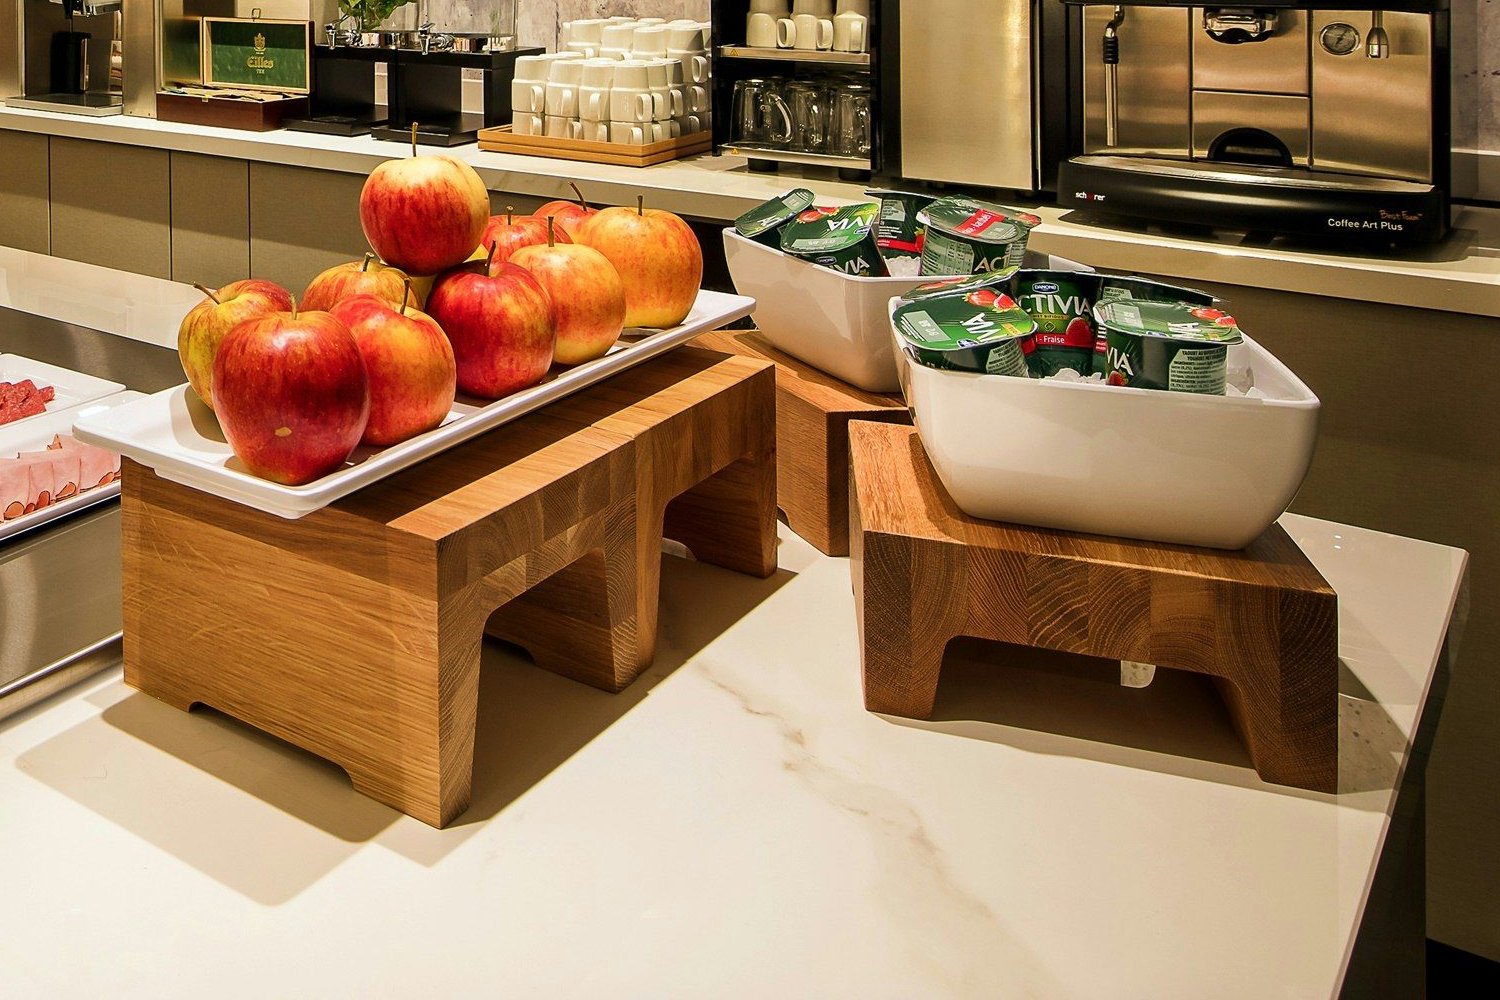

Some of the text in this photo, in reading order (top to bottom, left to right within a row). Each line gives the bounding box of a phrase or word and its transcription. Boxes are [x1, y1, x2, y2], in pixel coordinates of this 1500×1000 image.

[827, 214, 874, 232] IVIA
[1327, 218, 1404, 231] Coffee Art Plus
[1018, 293, 1094, 318] CTIVIA
[1043, 335, 1065, 344] Fraise
